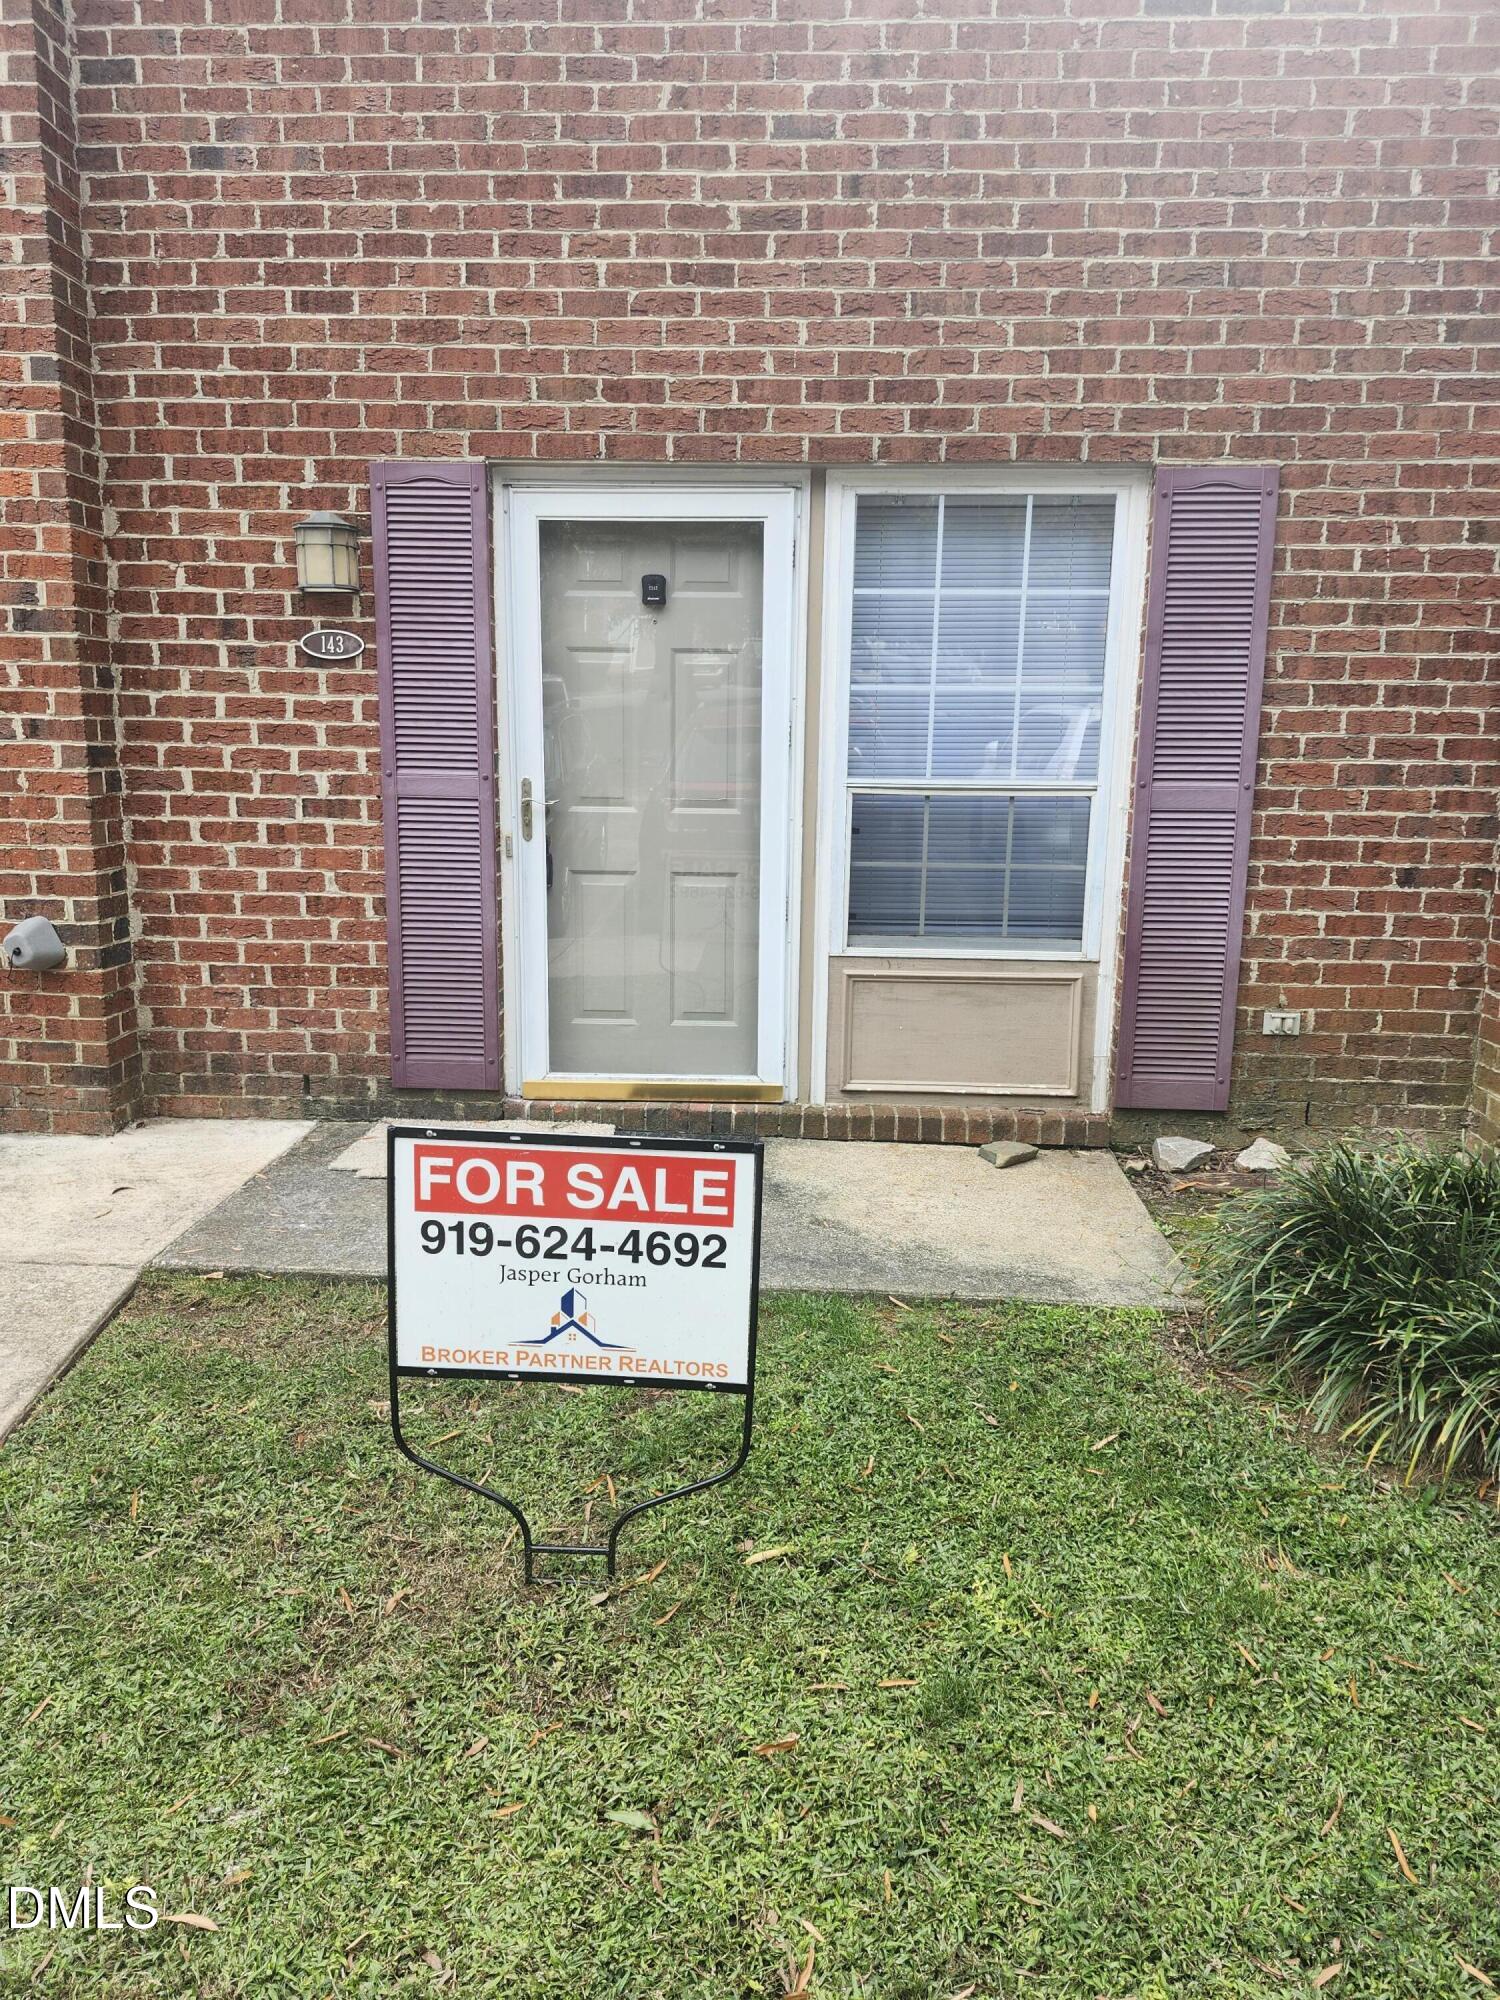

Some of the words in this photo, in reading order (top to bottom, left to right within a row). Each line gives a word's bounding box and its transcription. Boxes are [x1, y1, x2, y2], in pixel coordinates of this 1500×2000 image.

[321, 635, 344, 653] 143
[419, 1156, 545, 1206] FOR
[566, 1163, 729, 1216] SALE
[420, 1219, 728, 1269] 919-624-4692
[499, 1264, 561, 1287] Jasper
[567, 1267, 647, 1287] Gorham
[421, 1346, 509, 1366] BROKER
[515, 1350, 613, 1371] PARTNER
[619, 1355, 729, 1378] REALTORS
